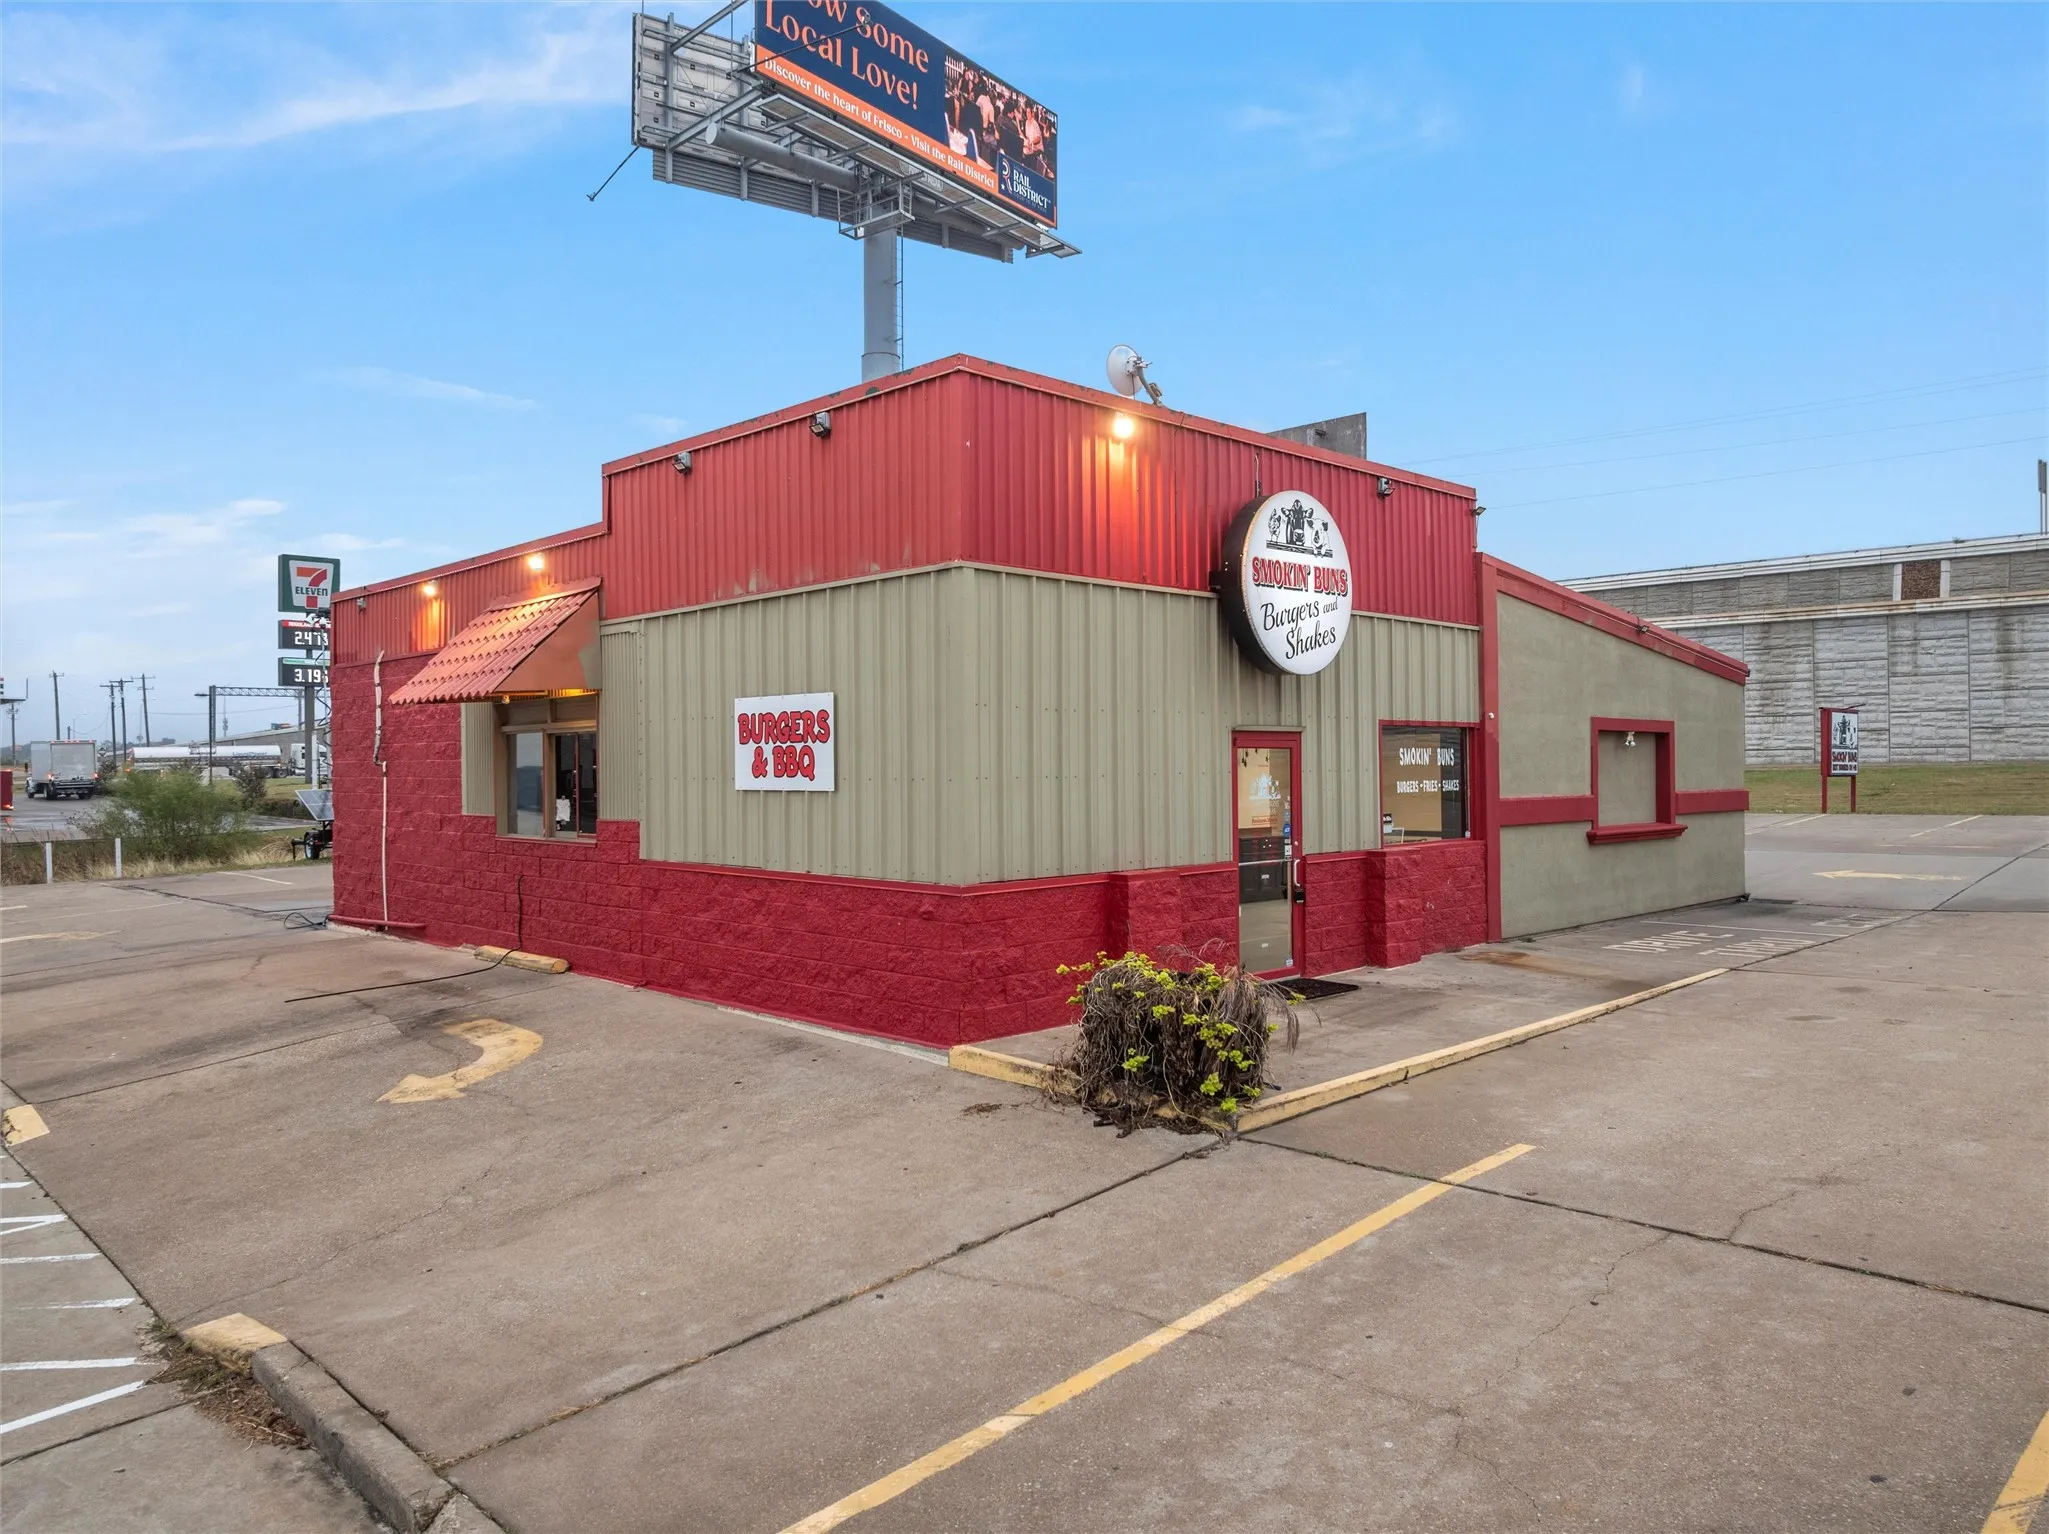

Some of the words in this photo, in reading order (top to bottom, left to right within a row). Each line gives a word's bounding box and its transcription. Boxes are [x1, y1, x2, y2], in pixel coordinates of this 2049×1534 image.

[765, 0, 843, 68] Local
[852, 46, 918, 111] Love!
[855, 6, 929, 74] Some
[764, 57, 812, 91] Discover
[814, 83, 831, 101] the
[832, 92, 860, 117] heart
[861, 109, 872, 123] of
[873, 116, 903, 139] Frisco
[911, 134, 931, 156] Visit
[932, 147, 946, 162] the
[947, 154, 964, 174] Rail
[964, 164, 995, 189] District
[1013, 169, 1032, 190] RAIL
[1013, 180, 1049, 209] DISTRICT
[1252, 556, 1311, 592] SMOKIN'
[1313, 566, 1349, 597] BUNS
[1260, 600, 1320, 634] Burgers
[1323, 596, 1339, 614] and
[1285, 620, 1337, 660] Shakes
[737, 709, 831, 745] BURGERS
[751, 745, 768, 779] &
[772, 745, 816, 782] BBQ
[1399, 747, 1432, 767] SMOKIN'
[1436, 748, 1455, 767] BUNS
[1396, 780, 1419, 794] BURGERS
[1423, 780, 1438, 792] FRIES
[1442, 779, 1460, 792] SHAKES
[1601, 930, 1735, 954] DRIVE
[1697, 937, 1818, 958] THRU
